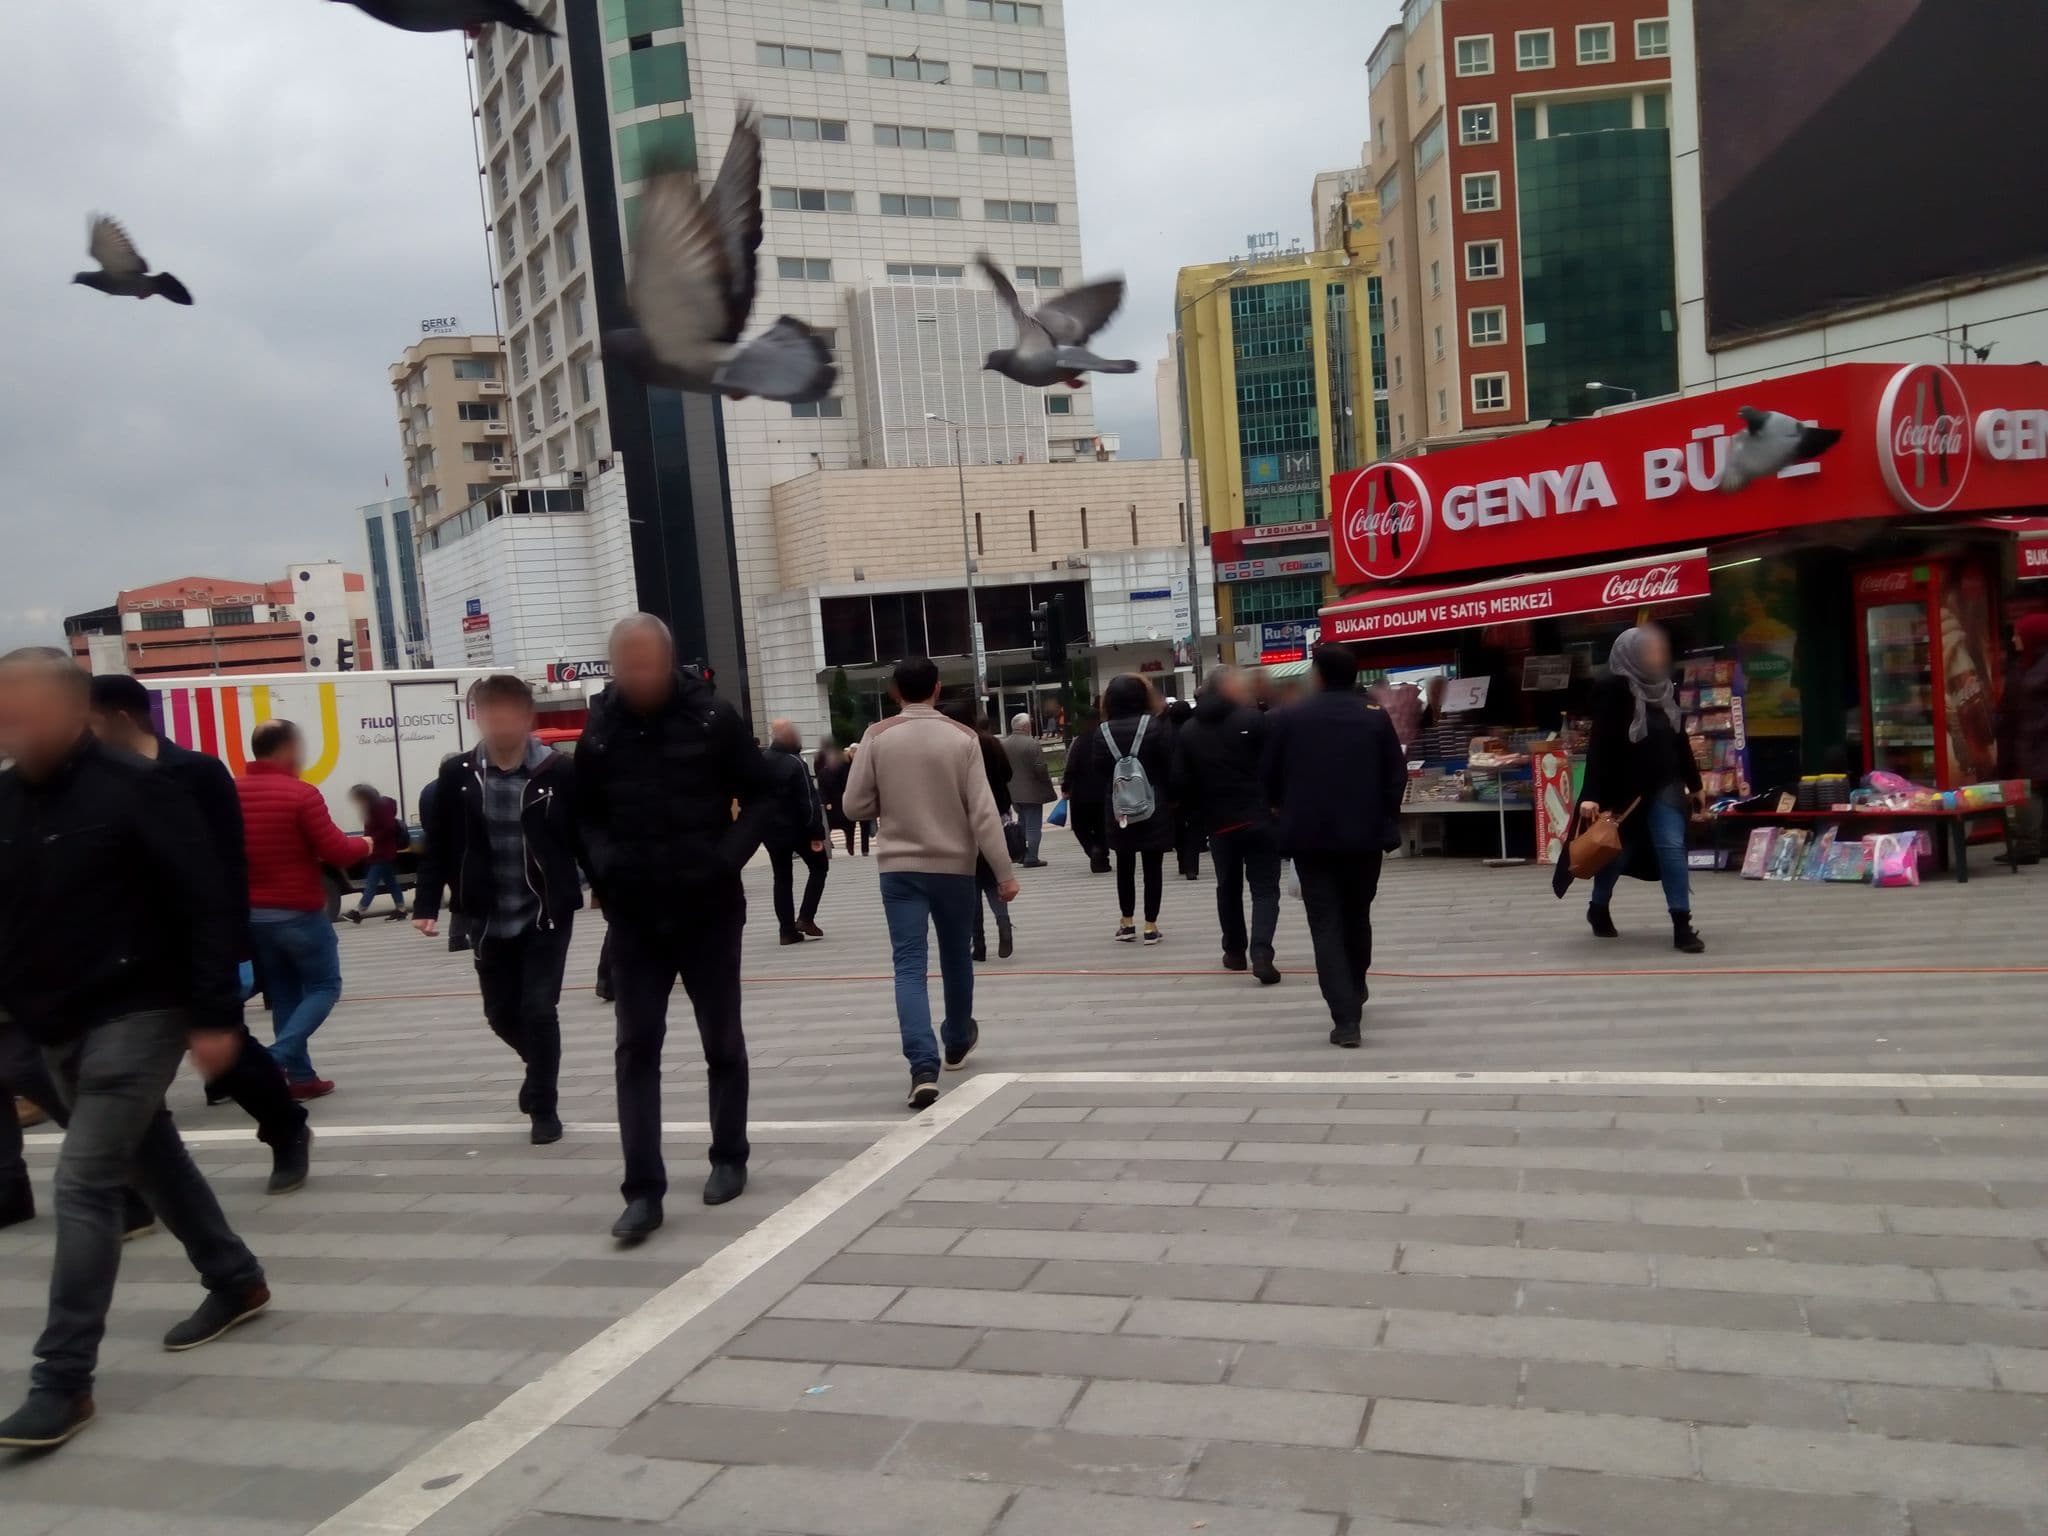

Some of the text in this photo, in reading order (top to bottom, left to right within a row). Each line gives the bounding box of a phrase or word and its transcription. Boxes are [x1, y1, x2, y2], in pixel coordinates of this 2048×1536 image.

[450, 316, 457, 327] 2
[1441, 461, 1618, 531] GENYA
[1349, 500, 1417, 540] Coca-Cola
[1335, 615, 1381, 635] BUKART
[1383, 608, 1427, 629] DOLUM
[1430, 605, 1447, 622] VE
[1450, 600, 1487, 619] SATIŞ
[1490, 588, 1553, 614] MERKEZİ
[1602, 564, 1682, 605] Coca-Cola
[397, 713, 455, 728] LOGISTICS
